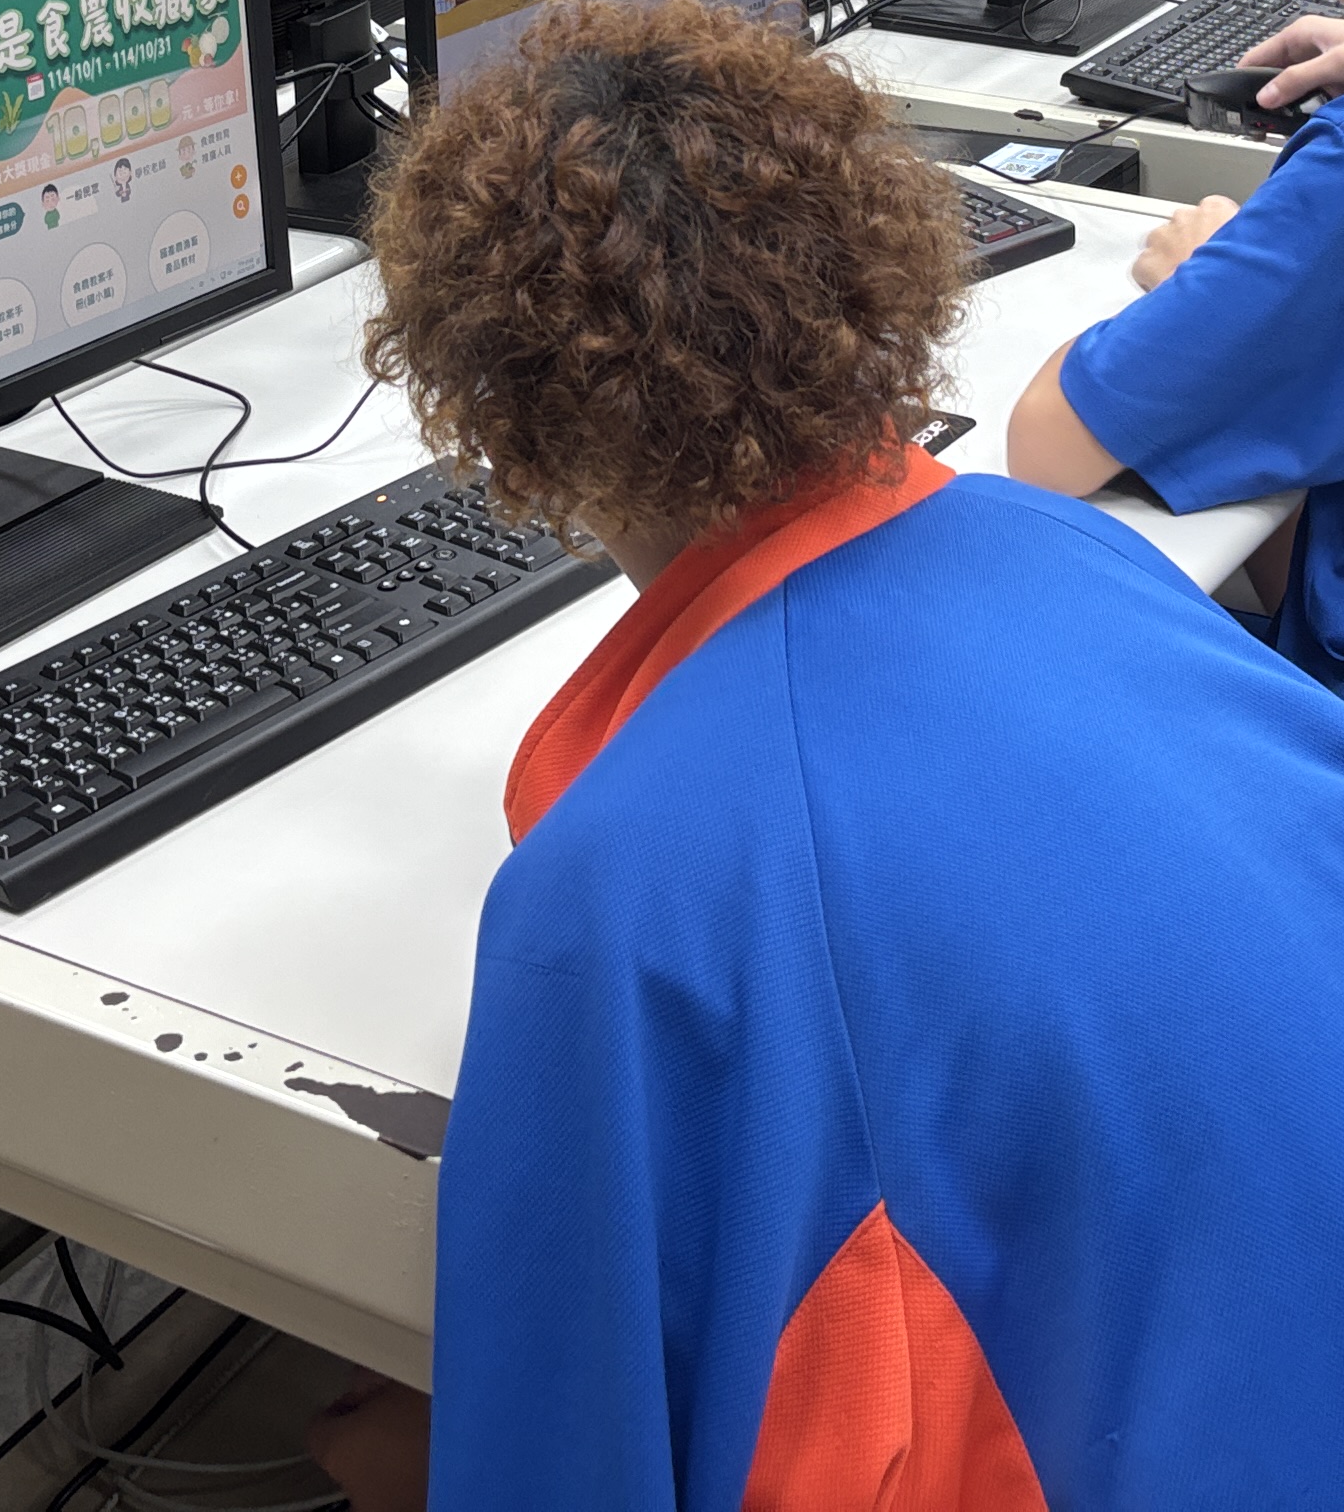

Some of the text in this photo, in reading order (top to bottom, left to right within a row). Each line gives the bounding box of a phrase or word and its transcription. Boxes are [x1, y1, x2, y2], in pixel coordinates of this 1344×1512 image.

[46, 56, 103, 91] 114/10/1
[113, 35, 172, 72] 114/10/31
[45, 77, 175, 165] 10,000
[134, 159, 168, 180] 學校老師
[65, 183, 101, 202] 一般民眾
